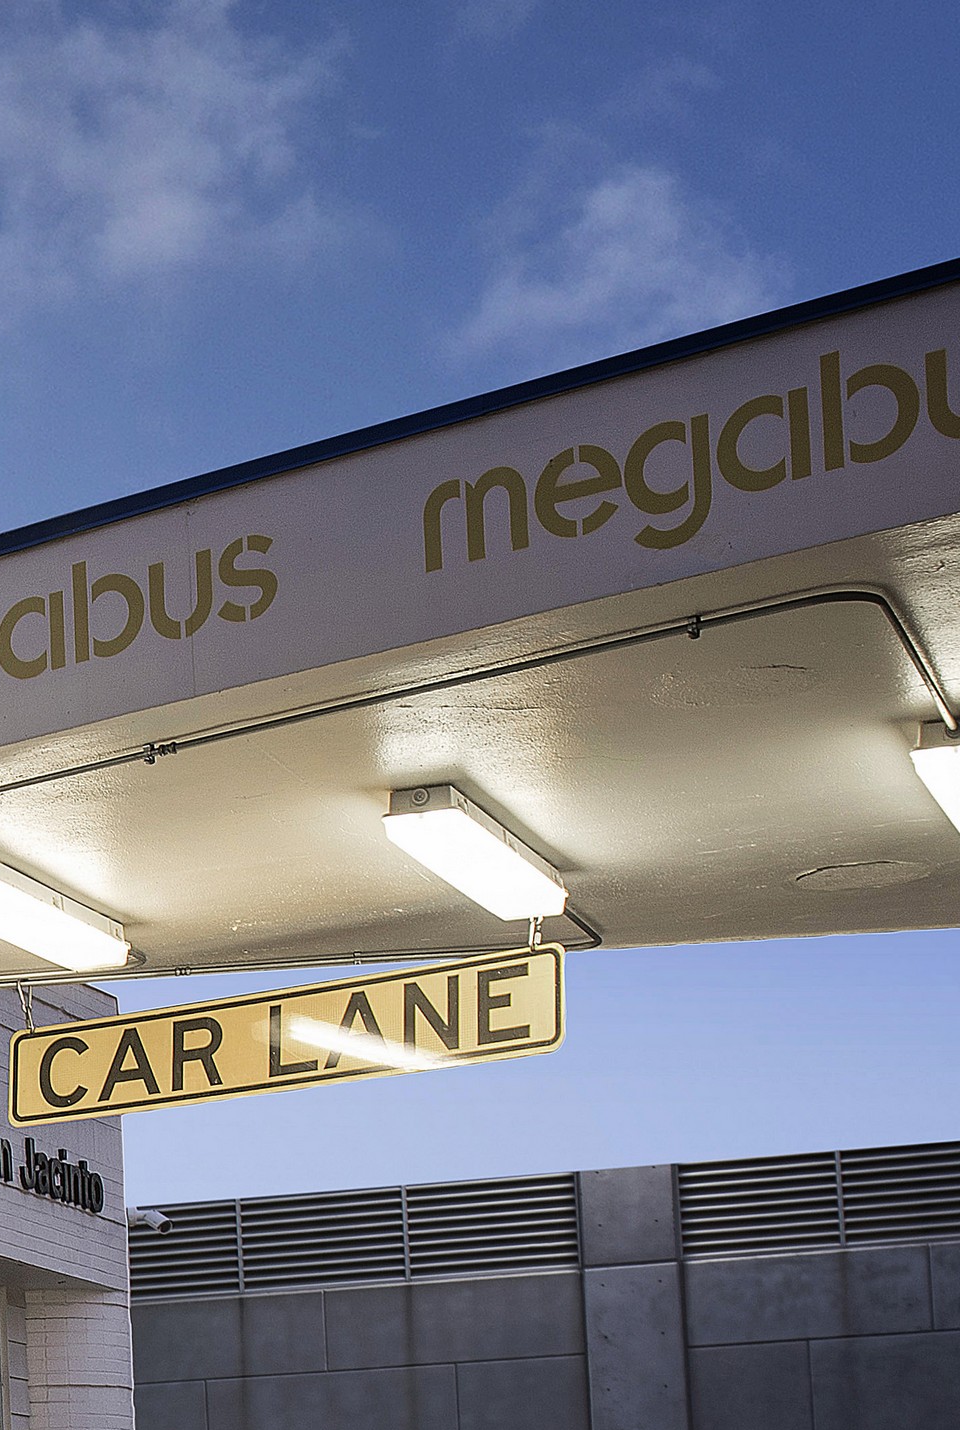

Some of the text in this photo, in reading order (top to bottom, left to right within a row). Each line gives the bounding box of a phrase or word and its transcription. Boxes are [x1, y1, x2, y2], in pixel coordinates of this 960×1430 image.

[40, 963, 531, 1108] CAR LANE
[19, 1137, 104, 1213] Jacinto
